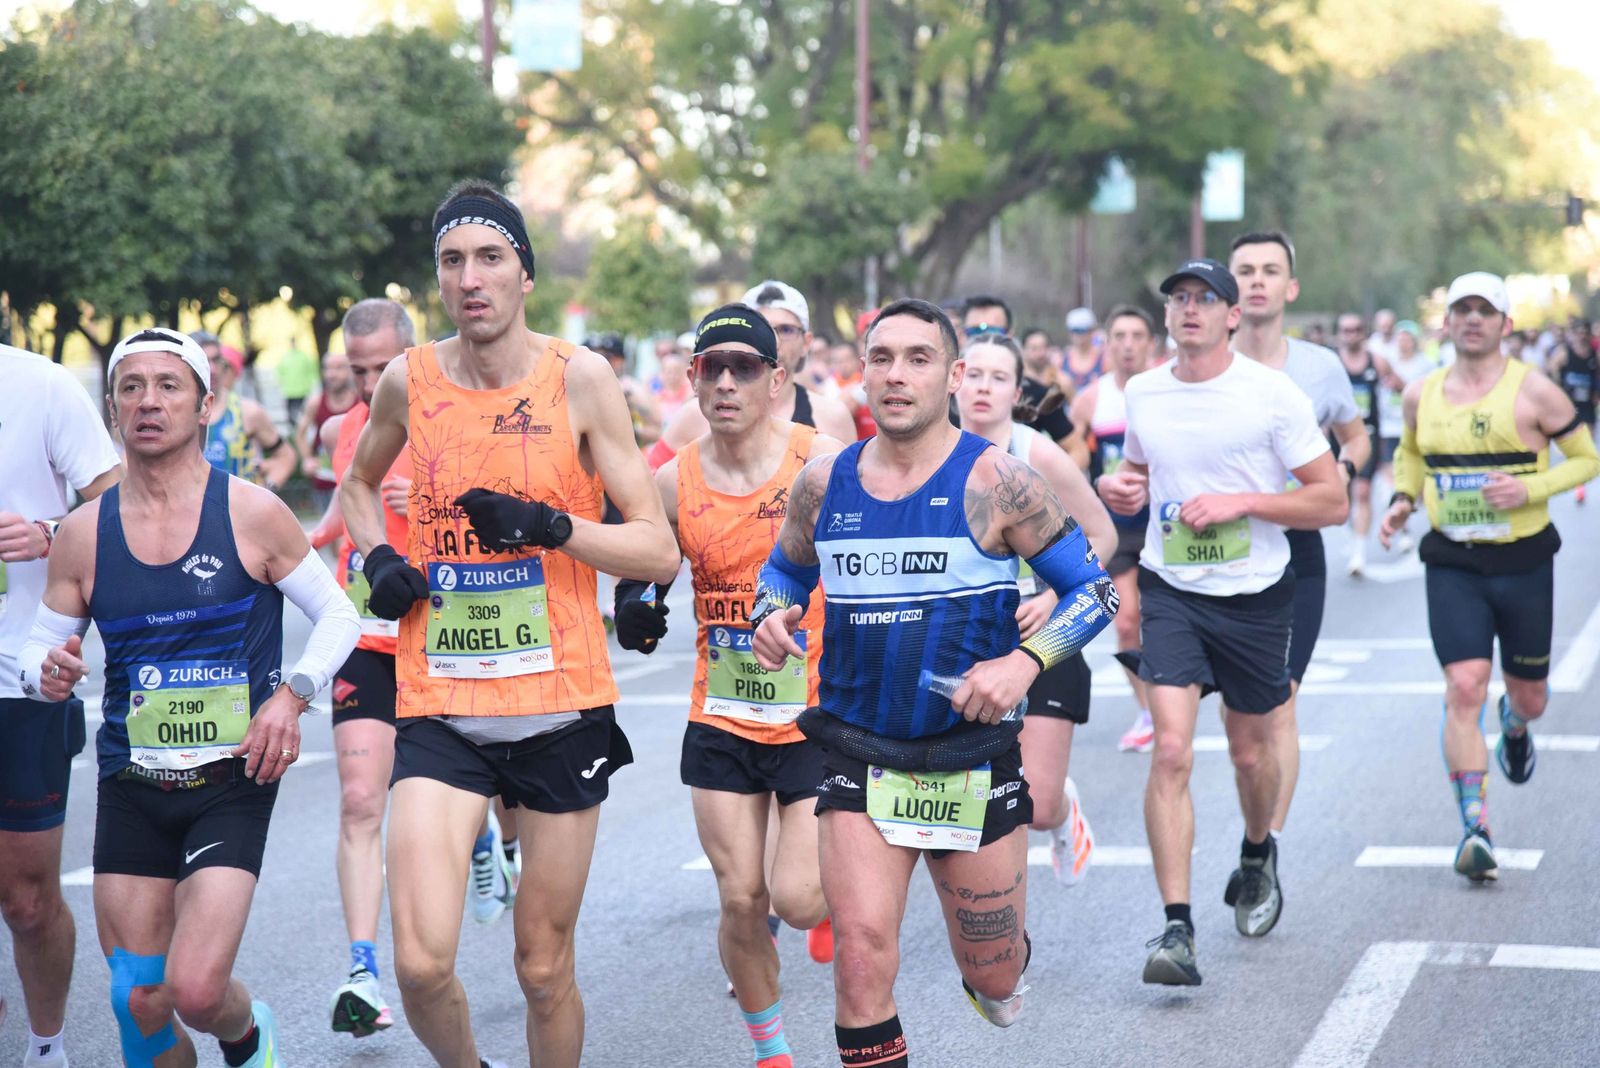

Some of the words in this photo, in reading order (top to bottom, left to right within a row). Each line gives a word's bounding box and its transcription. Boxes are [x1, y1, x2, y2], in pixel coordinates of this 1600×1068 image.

[1187, 545, 1224, 562] SHAI
[831, 552, 898, 577] TGCB
[903, 553, 946, 572] INN
[463, 566, 529, 586] ZURICH
[175, 610, 197, 621] 1979
[467, 604, 501, 621] 3309
[705, 599, 726, 622] LA
[436, 627, 509, 651] ANGEL
[516, 623, 539, 646] G.
[168, 666, 233, 683] ZURICH
[735, 678, 776, 701] PIRO
[168, 699, 204, 715] 2190
[157, 720, 218, 744] OIHID
[185, 778, 206, 789] Trail
[914, 780, 945, 793] 1541
[893, 796, 962, 823] LUQUE
